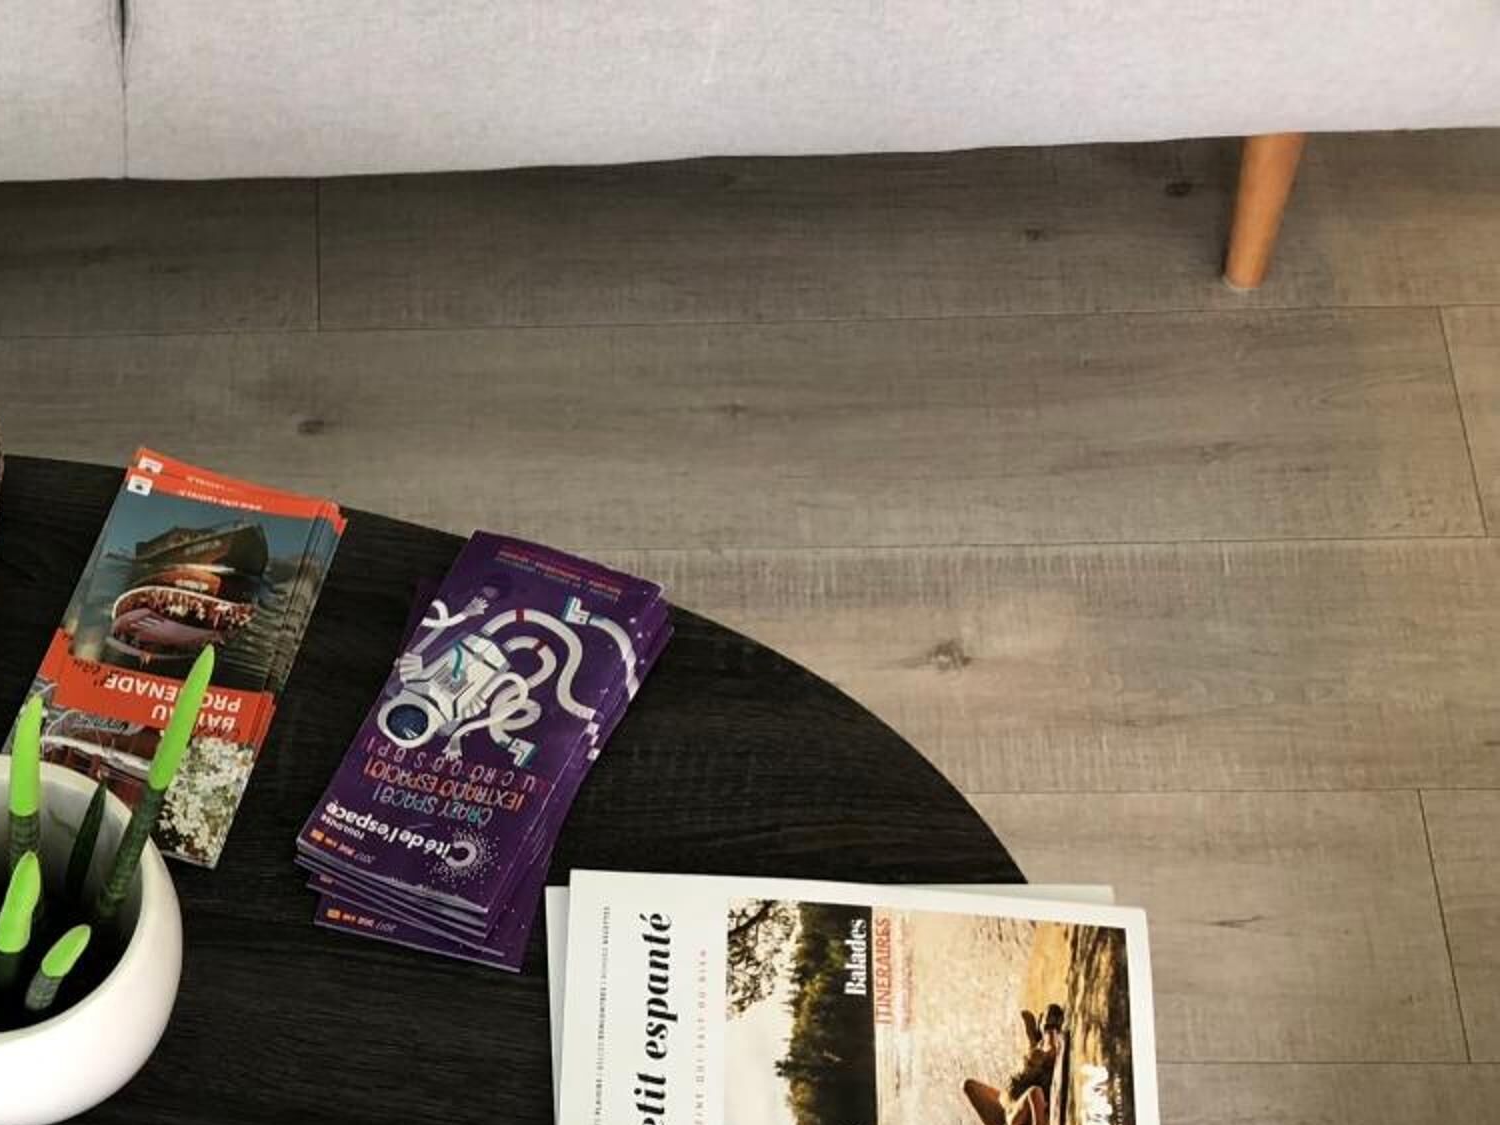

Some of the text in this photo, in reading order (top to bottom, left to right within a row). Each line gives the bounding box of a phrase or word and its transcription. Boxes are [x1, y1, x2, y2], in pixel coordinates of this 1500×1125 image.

[102, 673, 241, 714] PROENADE
[635, 911, 680, 1061] espanté
[842, 917, 867, 995] Balades
